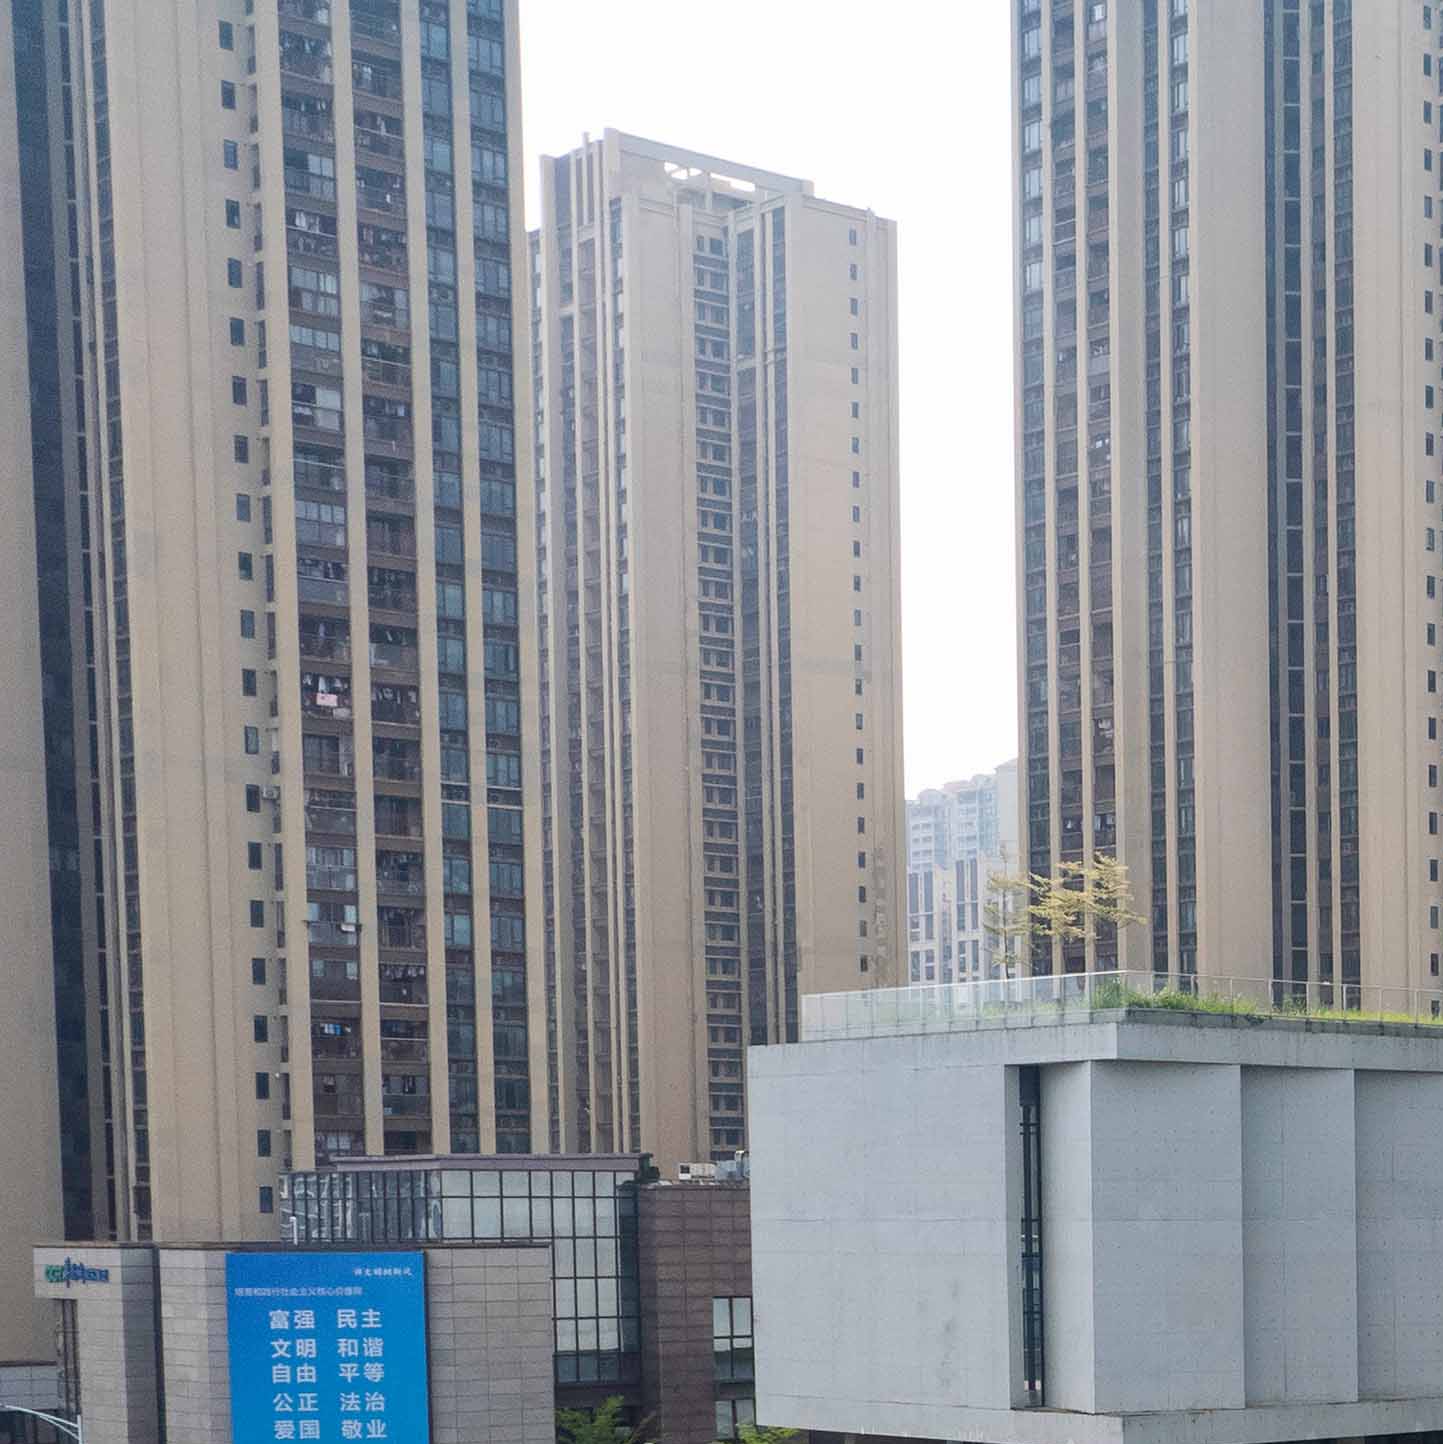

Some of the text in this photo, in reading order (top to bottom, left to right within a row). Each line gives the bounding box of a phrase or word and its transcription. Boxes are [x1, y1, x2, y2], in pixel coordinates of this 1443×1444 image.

[269, 1309, 383, 1330] 富强 民主
[270, 1337, 384, 1359] 文明 和谐
[271, 1363, 385, 1384] 自由 平等
[273, 1391, 385, 1413] 公正 法治
[274, 1420, 388, 1440] 爱国 敬业
